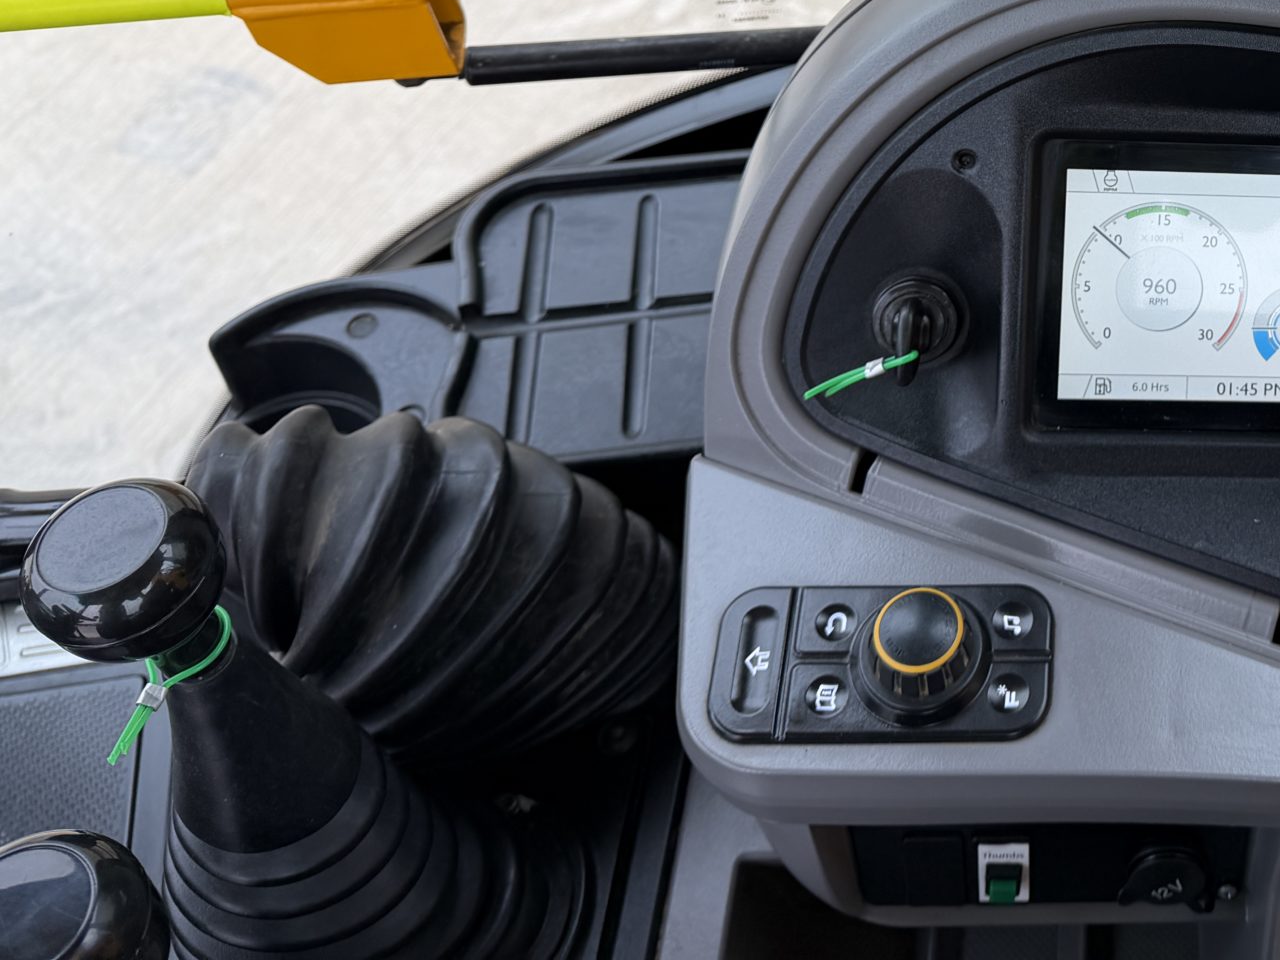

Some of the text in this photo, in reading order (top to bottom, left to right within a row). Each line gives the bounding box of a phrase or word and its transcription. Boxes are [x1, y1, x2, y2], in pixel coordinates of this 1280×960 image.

[1156, 214, 1171, 226] 15
[1202, 235, 1218, 248] 20
[1083, 280, 1091, 292] 5
[1142, 278, 1177, 295] 960
[1220, 282, 1235, 295] 25
[1148, 297, 1169, 306] RPM
[1103, 327, 1112, 339] 0
[1198, 328, 1214, 341] 30
[1132, 381, 1170, 393] 6.0 Hrs
[1216, 382, 1259, 397] 01:45
[1151, 878, 1184, 900] 12V
